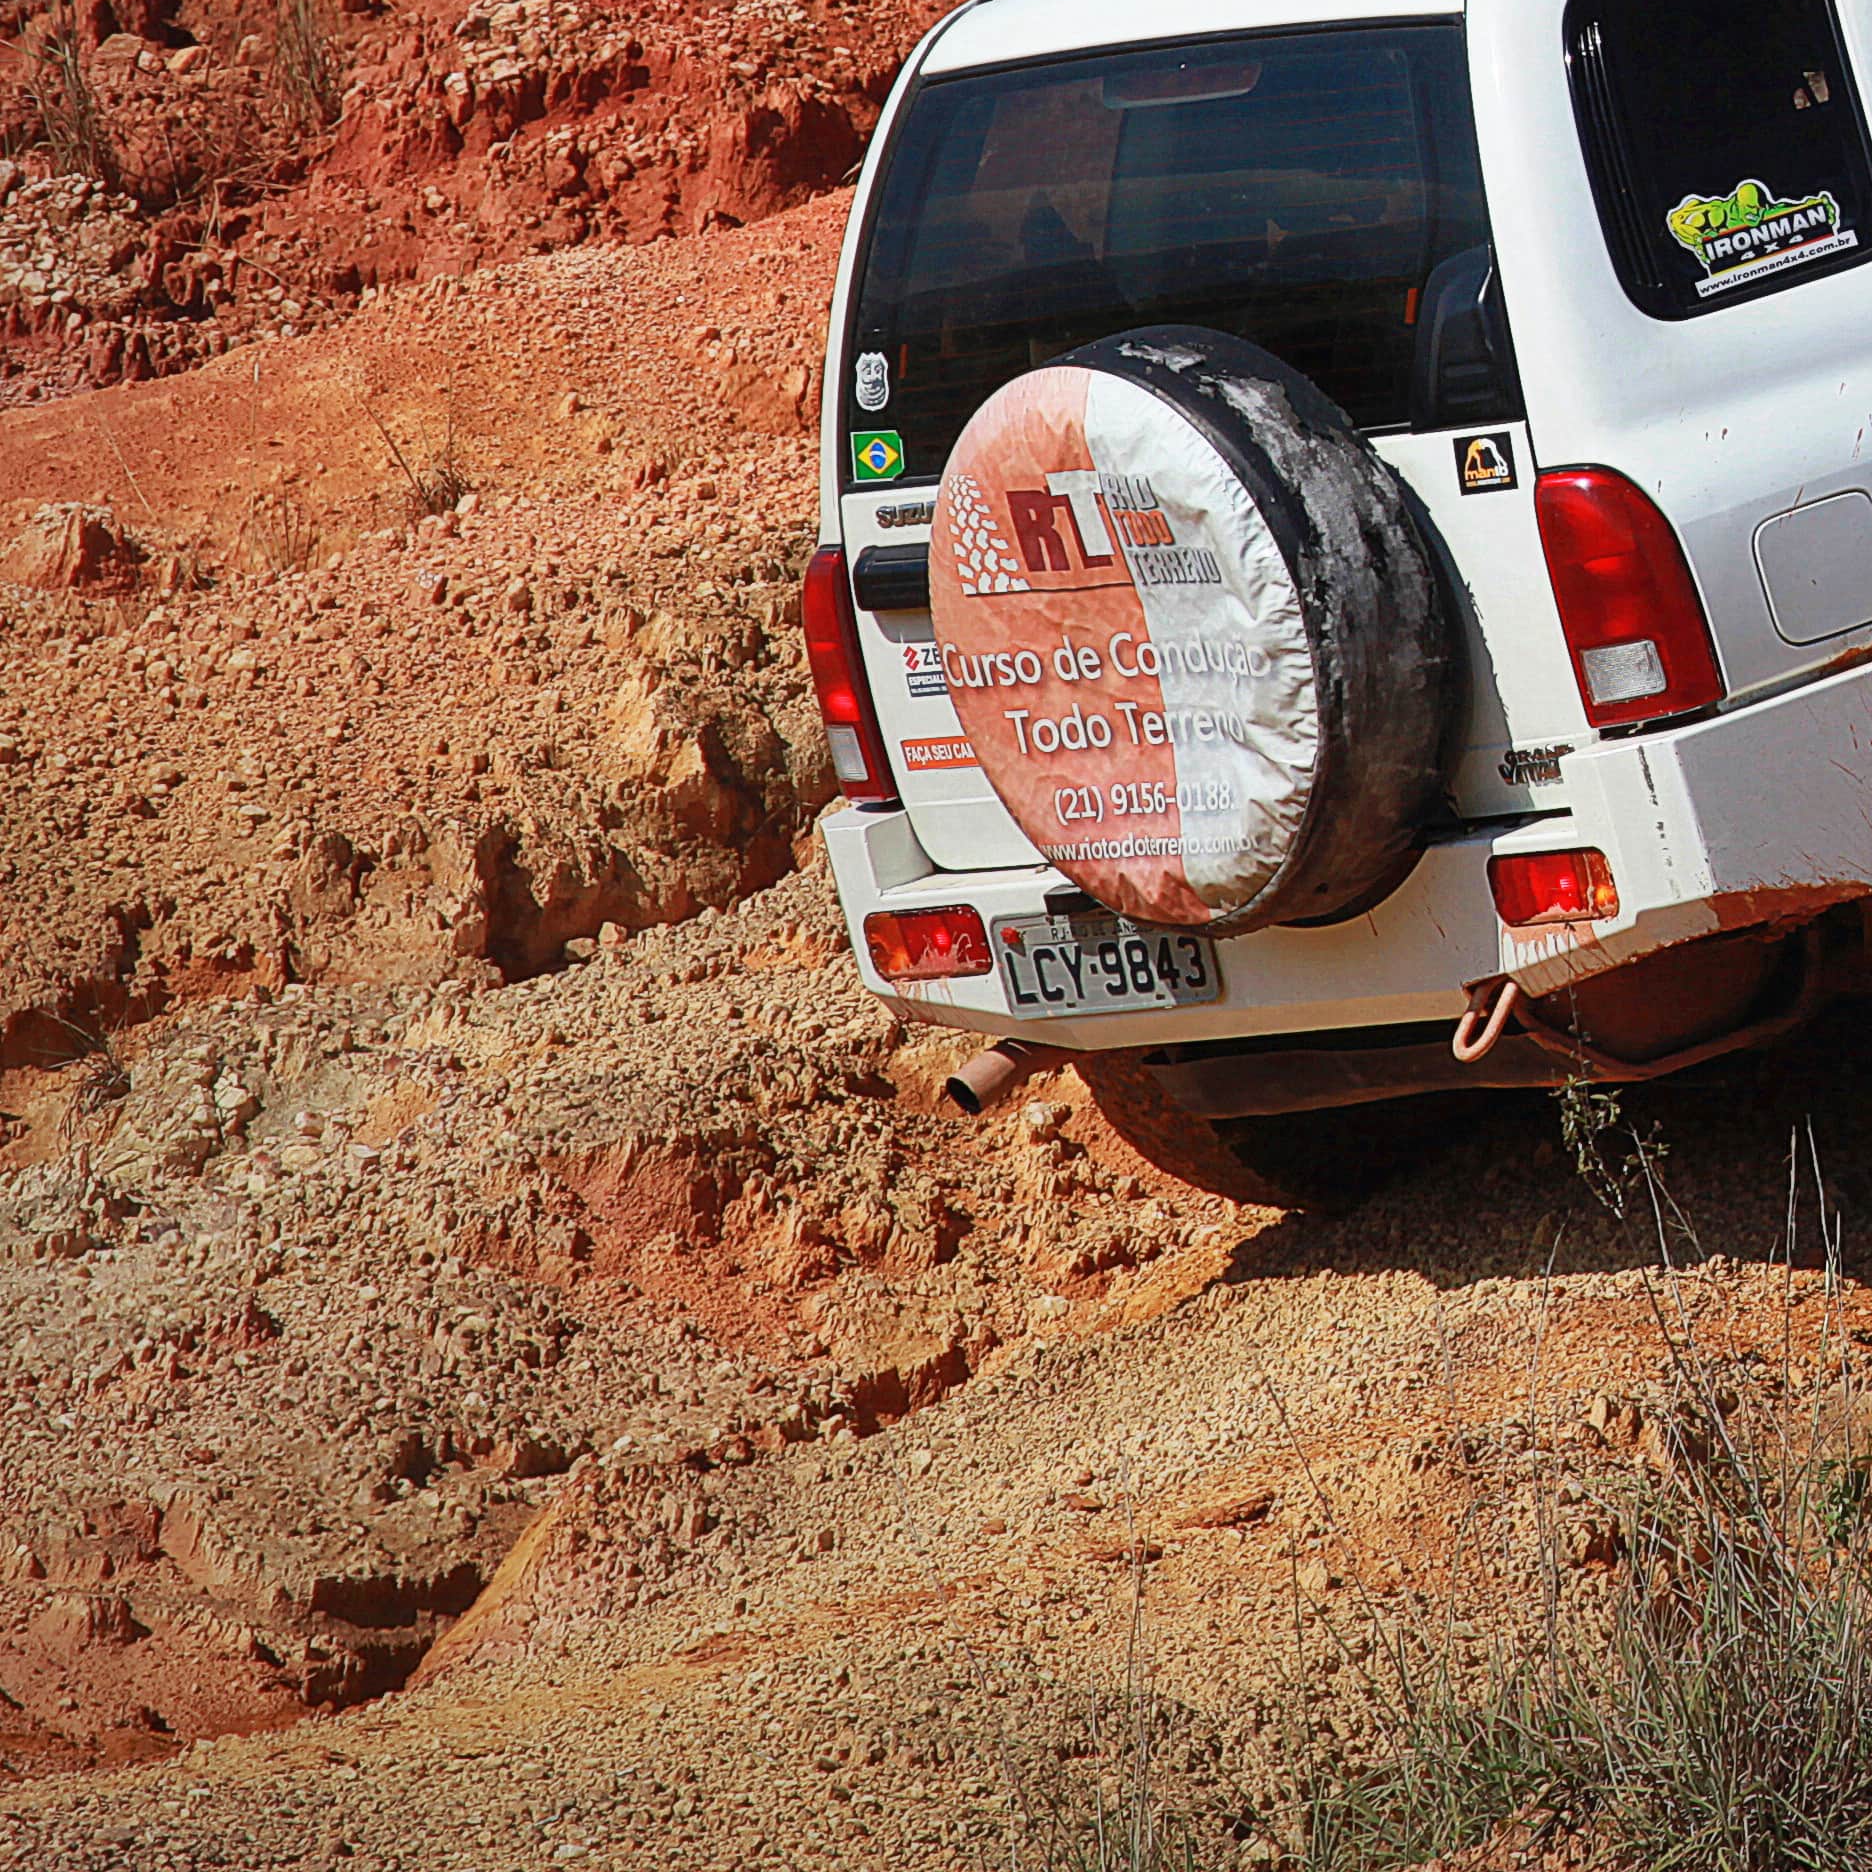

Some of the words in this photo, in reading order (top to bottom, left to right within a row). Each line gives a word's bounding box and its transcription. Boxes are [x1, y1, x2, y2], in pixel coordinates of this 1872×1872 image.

[1705, 205, 1827, 261] IRONMAN
[1700, 237, 1851, 294] www.ironman4x4.com.br
[1100, 473, 1160, 511] RIO
[1112, 510, 1176, 547] TODO
[1128, 546, 1223, 586] TERRENO
[942, 642, 1043, 689] Curso
[1053, 634, 1101, 681] de
[1109, 631, 1271, 689] Condução
[1003, 703, 1112, 756] Todo
[1114, 701, 1245, 745] Terreno
[904, 745, 932, 765] FAÇA
[931, 744, 954, 760] SEU
[1054, 784, 1104, 826] (21)
